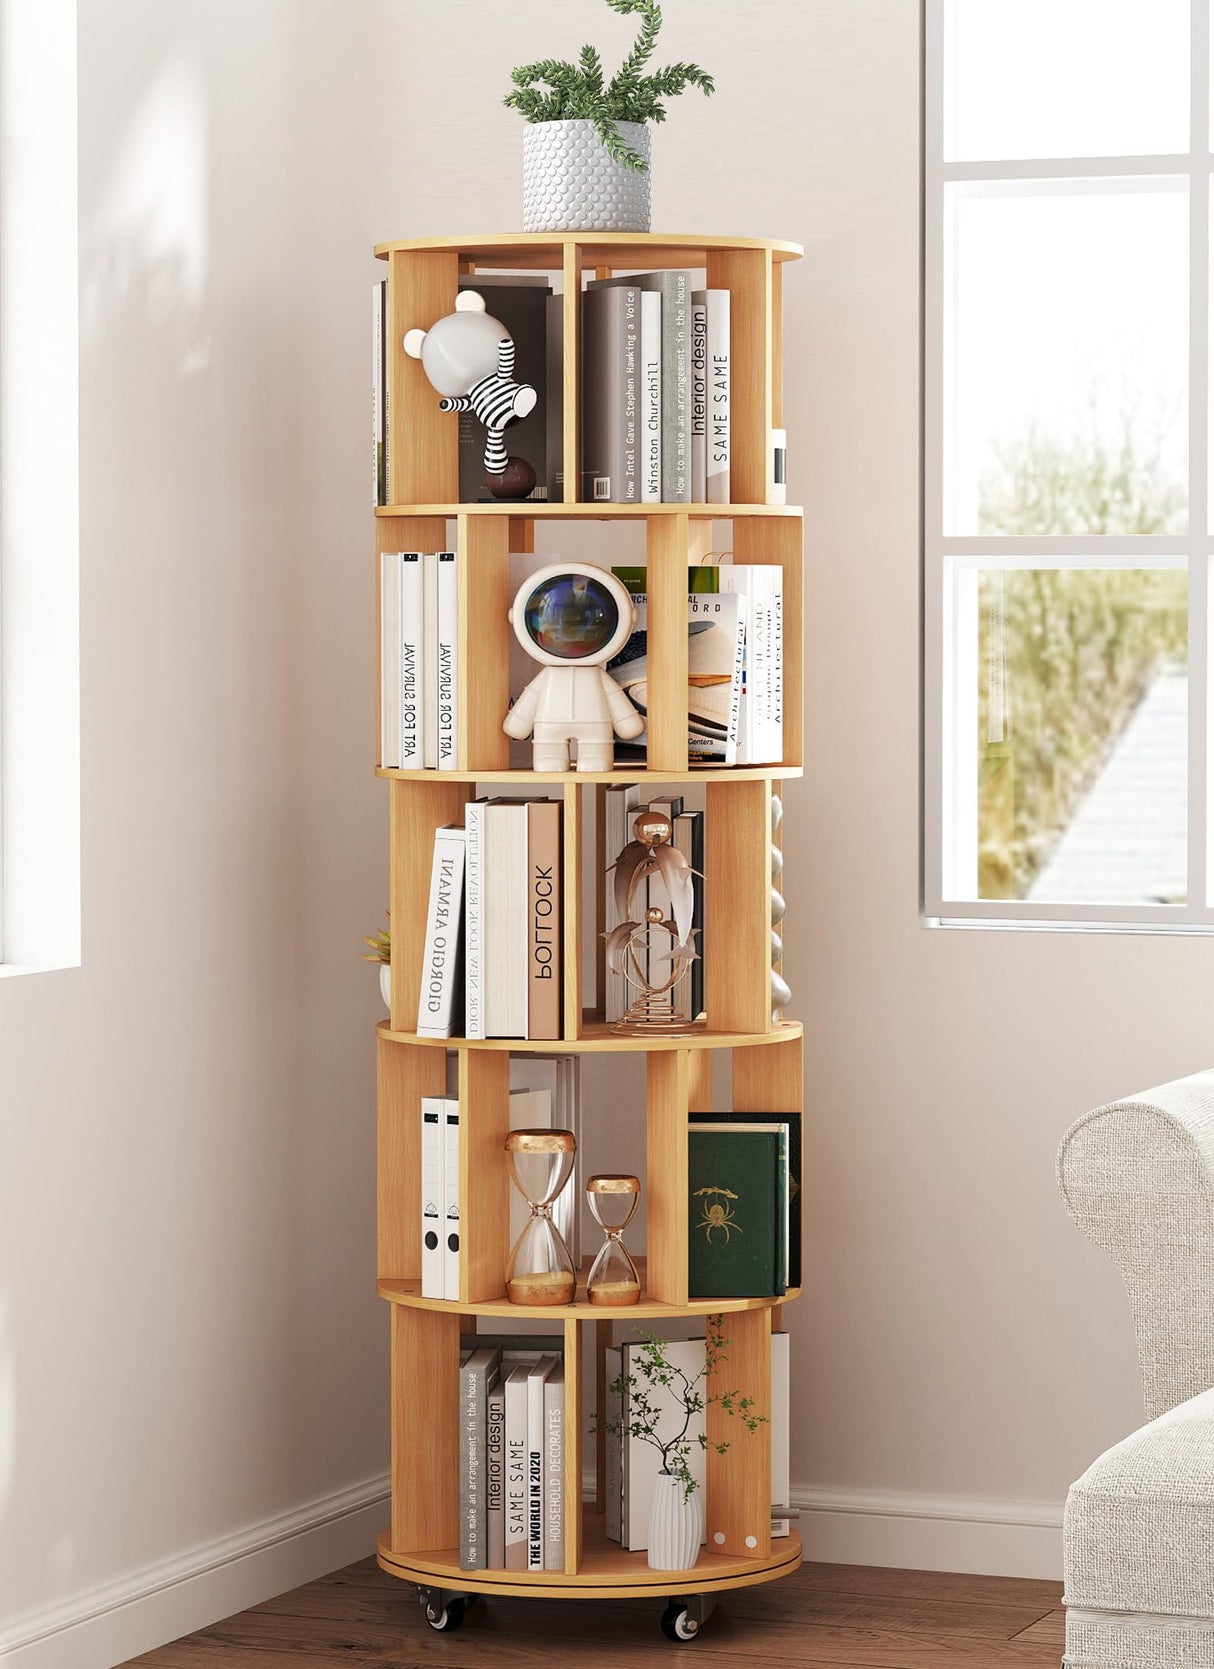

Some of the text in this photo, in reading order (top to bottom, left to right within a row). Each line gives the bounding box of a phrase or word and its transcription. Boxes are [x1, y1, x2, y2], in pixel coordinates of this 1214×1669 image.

[626, 292, 635, 318] Voice
[626, 335, 636, 373] Hawking
[626, 378, 635, 416] Stephen
[676, 276, 686, 494] How to make an arrangement in the house
[691, 312, 707, 436] Interior design
[714, 355, 727, 461] SAME SAME
[626, 449, 635, 475] Intel
[627, 422, 635, 443] Gave
[648, 361, 658, 493] Winston Churchill
[626, 481, 635, 498] How
[692, 604, 720, 612] ORD
[729, 621, 744, 741] Architectural
[688, 738, 713, 746] Centers
[468, 1374, 478, 1562] How to make an arrangement in the house
[487, 1403, 503, 1510] Interior design
[510, 1440, 523, 1533] SAME SAME
[550, 1409, 561, 1542] HOUSEHOLD DECORATES
[530, 1452, 540, 1565] THE WORLD IN 2020
